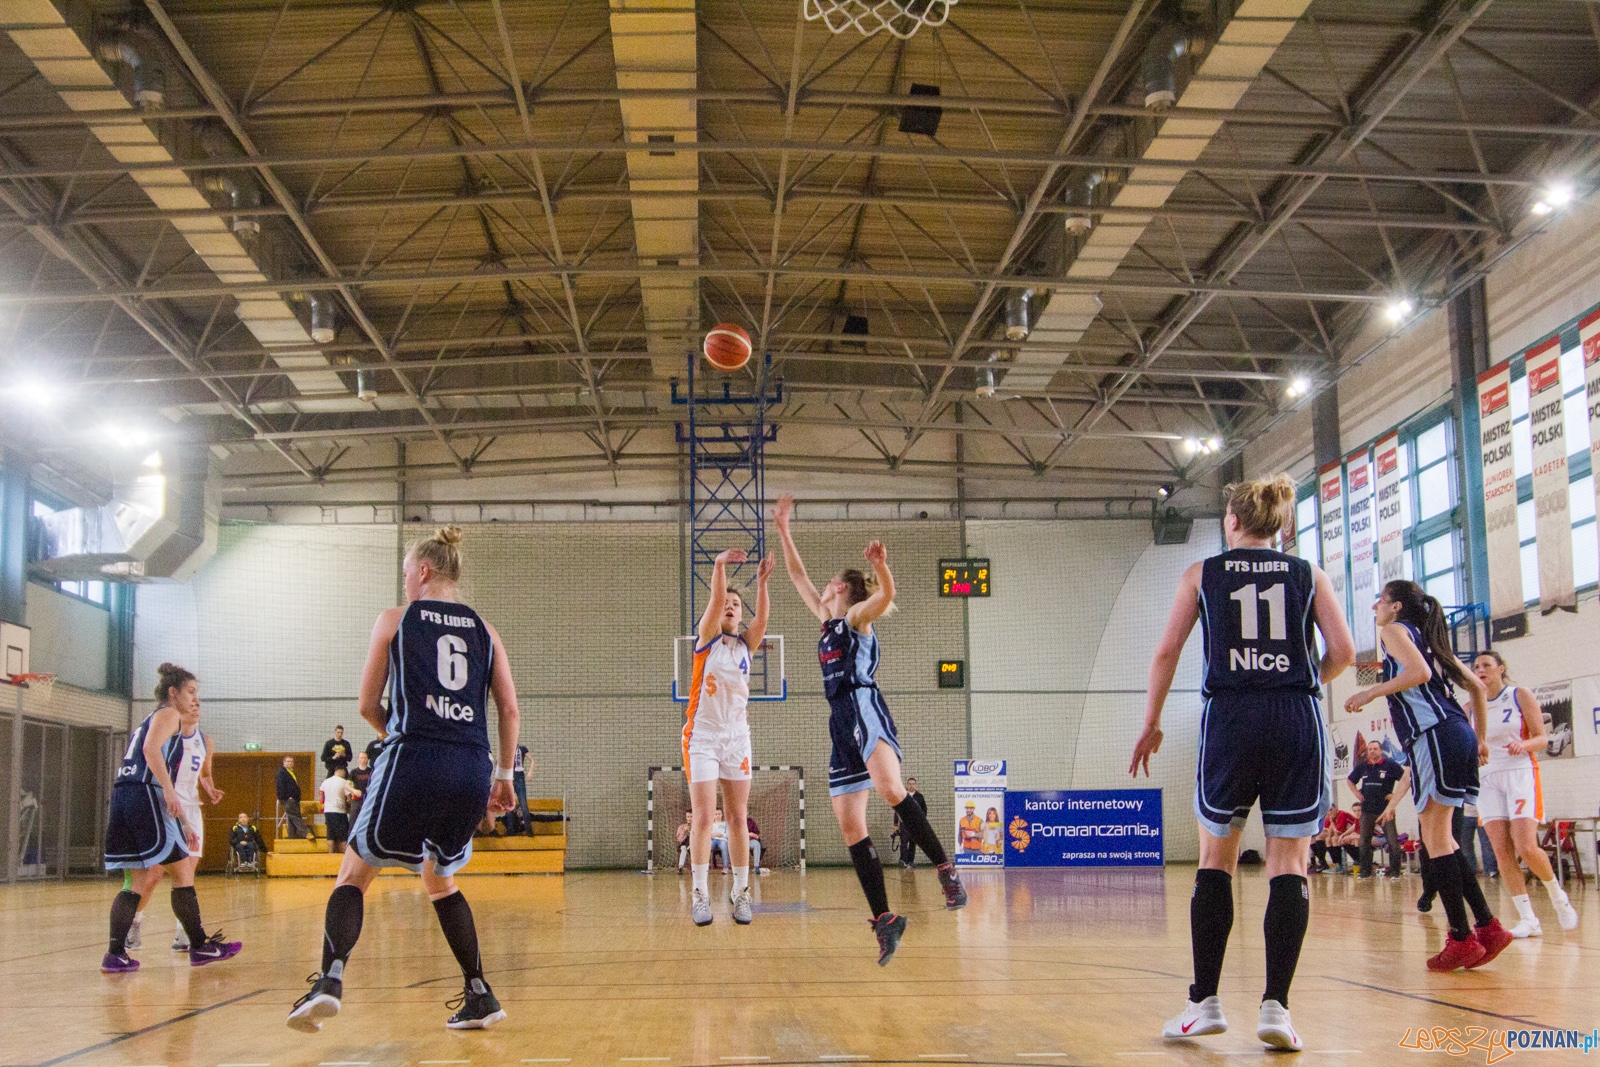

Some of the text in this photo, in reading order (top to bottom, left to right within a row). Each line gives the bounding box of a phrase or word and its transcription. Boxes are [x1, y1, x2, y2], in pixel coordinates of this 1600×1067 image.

[1531, 399, 1561, 426] MISTRZ
[1483, 420, 1511, 446] MISTRZ
[1532, 422, 1563, 449] POLSKI
[1483, 442, 1512, 467] POLSKI
[1534, 457, 1566, 478] KADETEK
[1485, 467, 1513, 487] JUNIOREK
[1379, 500, 1400, 522] POLSKI
[1323, 525, 1342, 541] POLSKI
[1350, 516, 1370, 534] POLSKI
[944, 569, 957, 580] 24
[978, 568, 988, 580] 12
[1224, 560, 1289, 573] PTS LIDER
[943, 583, 950, 594] 5
[980, 583, 987, 594] 5
[420, 609, 476, 628] PTS LIDER
[1230, 583, 1287, 640] 11
[436, 634, 468, 691] 6
[739, 657, 748, 675] 4
[1230, 647, 1290, 672] Nice
[425, 694, 474, 723] Nice
[1502, 708, 1512, 723] 7
[191, 755, 200, 772] 5
[740, 757, 750, 775] 4
[972, 764, 996, 772] LOBO
[1025, 799, 1143, 812] kantor internetowy
[1514, 798, 1526, 815] 7
[1062, 852, 1096, 860] zaprasza
[1109, 851, 1132, 860] swoją
[1134, 851, 1160, 860] stronę
